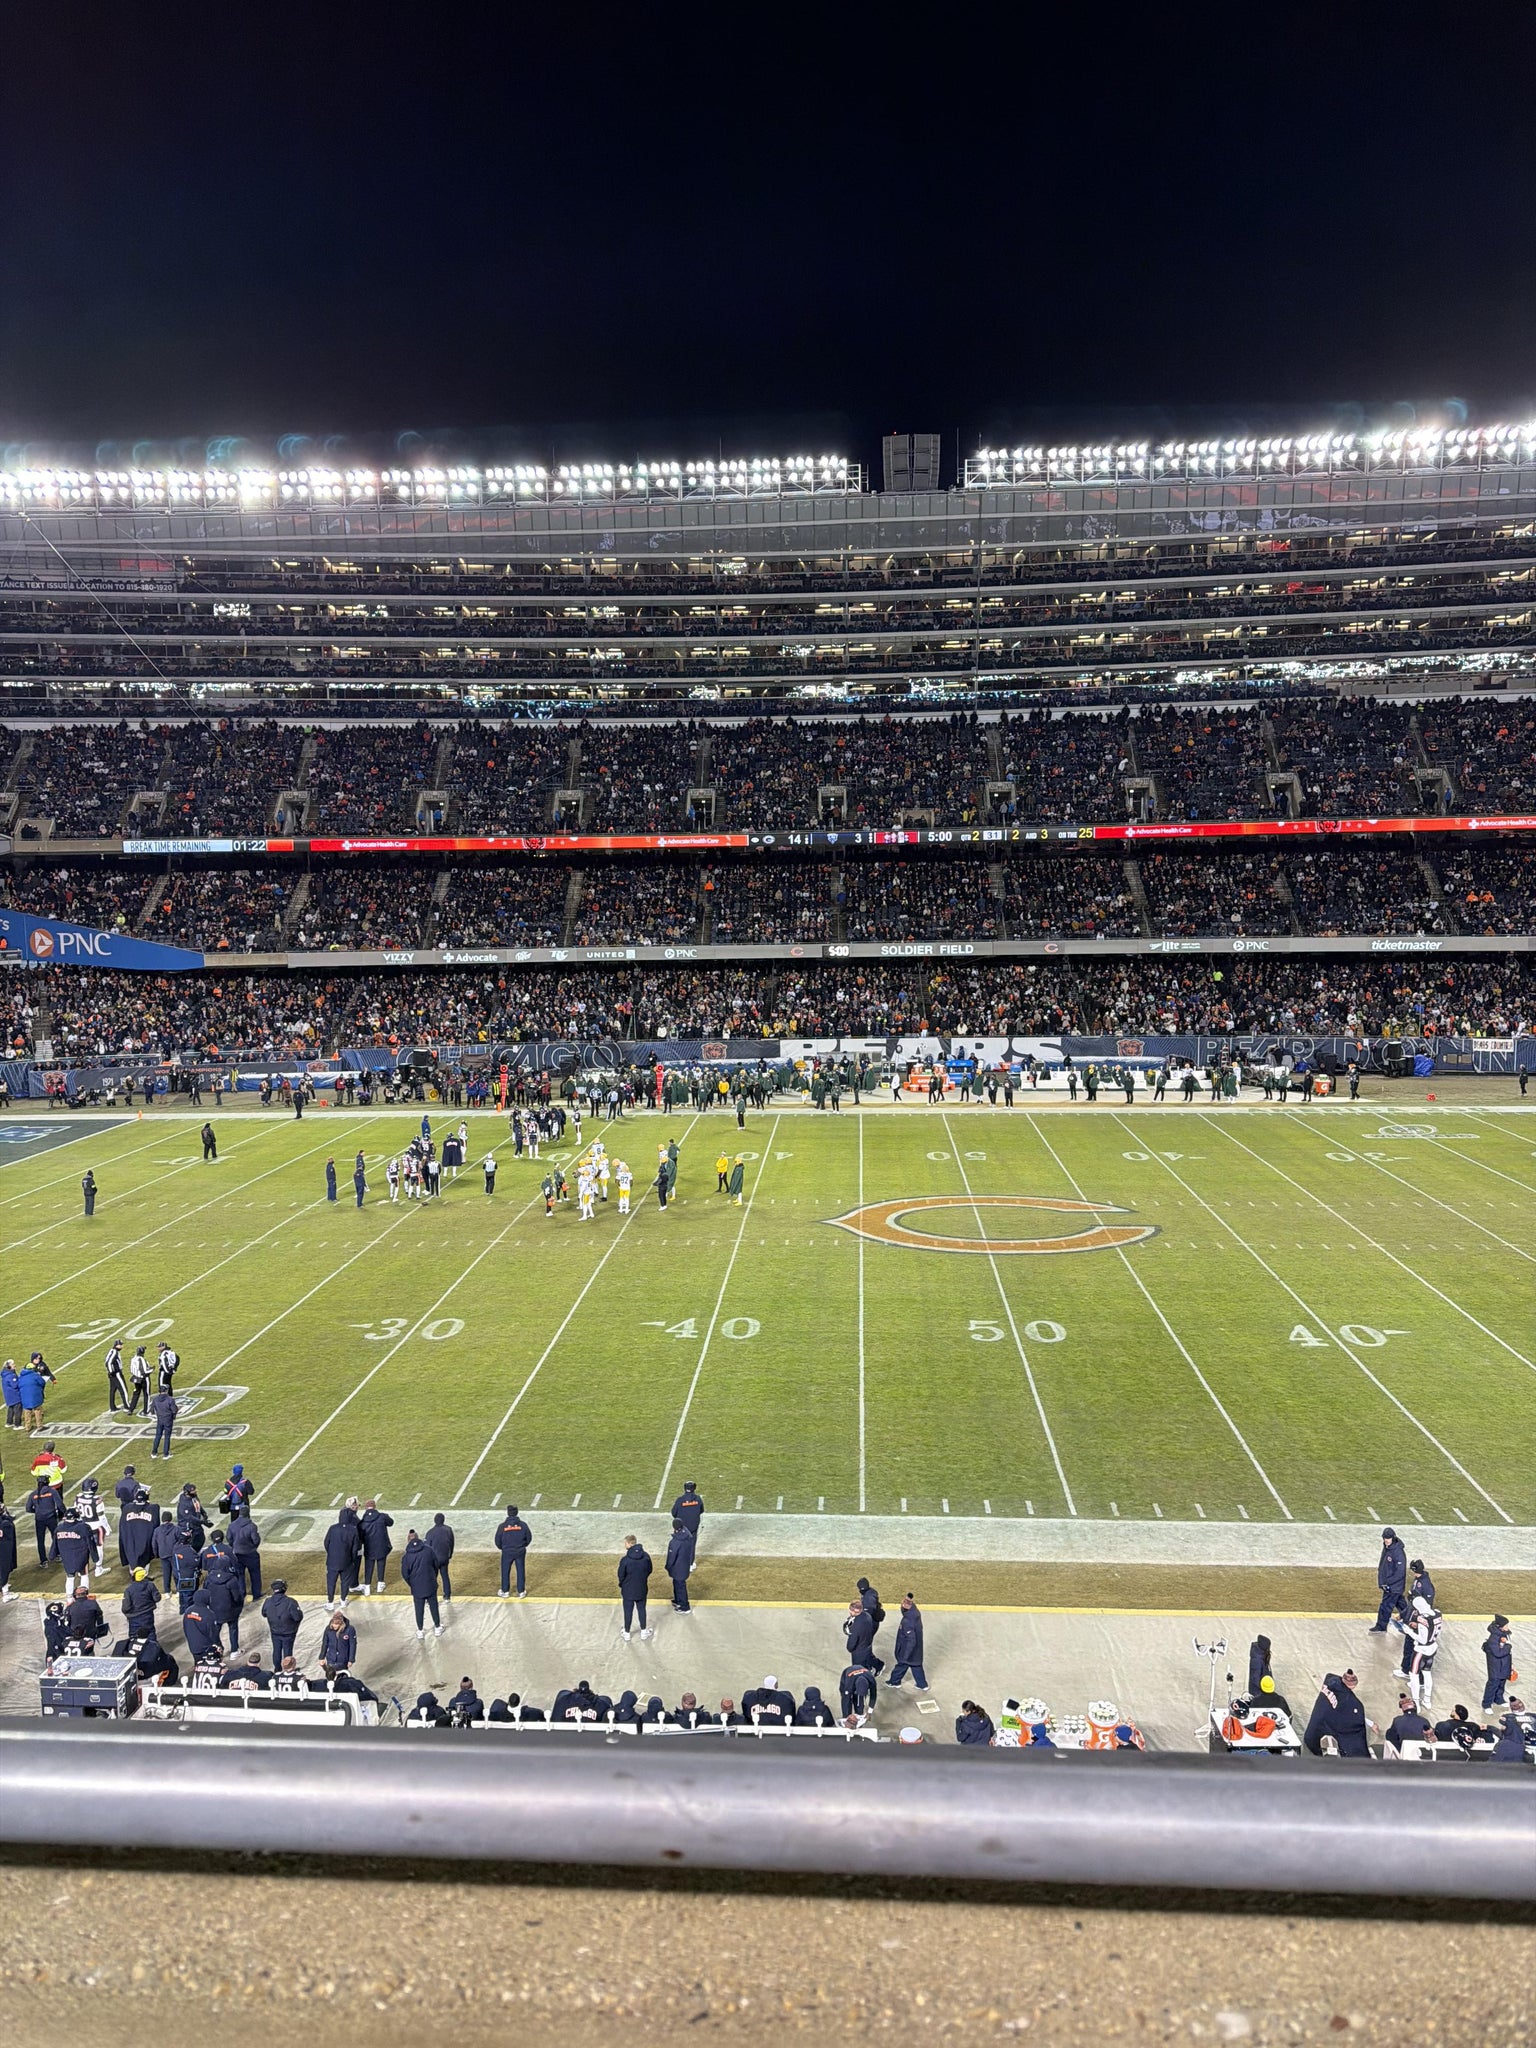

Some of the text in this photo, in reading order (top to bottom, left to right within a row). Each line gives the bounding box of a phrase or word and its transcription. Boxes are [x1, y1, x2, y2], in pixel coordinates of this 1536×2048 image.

[26, 582, 45, 590] TEXT
[47, 582, 68, 591] ISSUE
[76, 583, 113, 592] LOCATION
[115, 583, 125, 592] TO
[788, 834, 801, 844] 14
[854, 833, 862, 843] 3
[928, 831, 952, 841] 5:00
[972, 831, 980, 841] 2
[1012, 830, 1020, 840] 2
[1040, 829, 1048, 839] 3
[1079, 828, 1093, 838] 25
[130, 841, 266, 852] BREAK TIME REMAINING 01:22
[57, 932, 112, 955] PNC
[881, 944, 974, 955] SOLDIER FIELD
[1246, 941, 1269, 950] PNC
[1371, 939, 1443, 951] ticketmaster
[383, 953, 415, 961] VIZZY
[456, 953, 498, 962] Advocate
[676, 950, 697, 958] PNC
[66, 1317, 175, 1341] 20
[363, 1317, 467, 1341] 30
[664, 1316, 762, 1340] 40
[967, 1318, 1067, 1344] 50
[1288, 1323, 1388, 1347] 40
[52, 1425, 132, 1437] WILD
[126, 1512, 153, 1522] CHICAGO
[229, 1678, 259, 1691] CHIAGO
[565, 1706, 597, 1721] CHIAGO
[751, 1703, 781, 1716] CHICAGO
